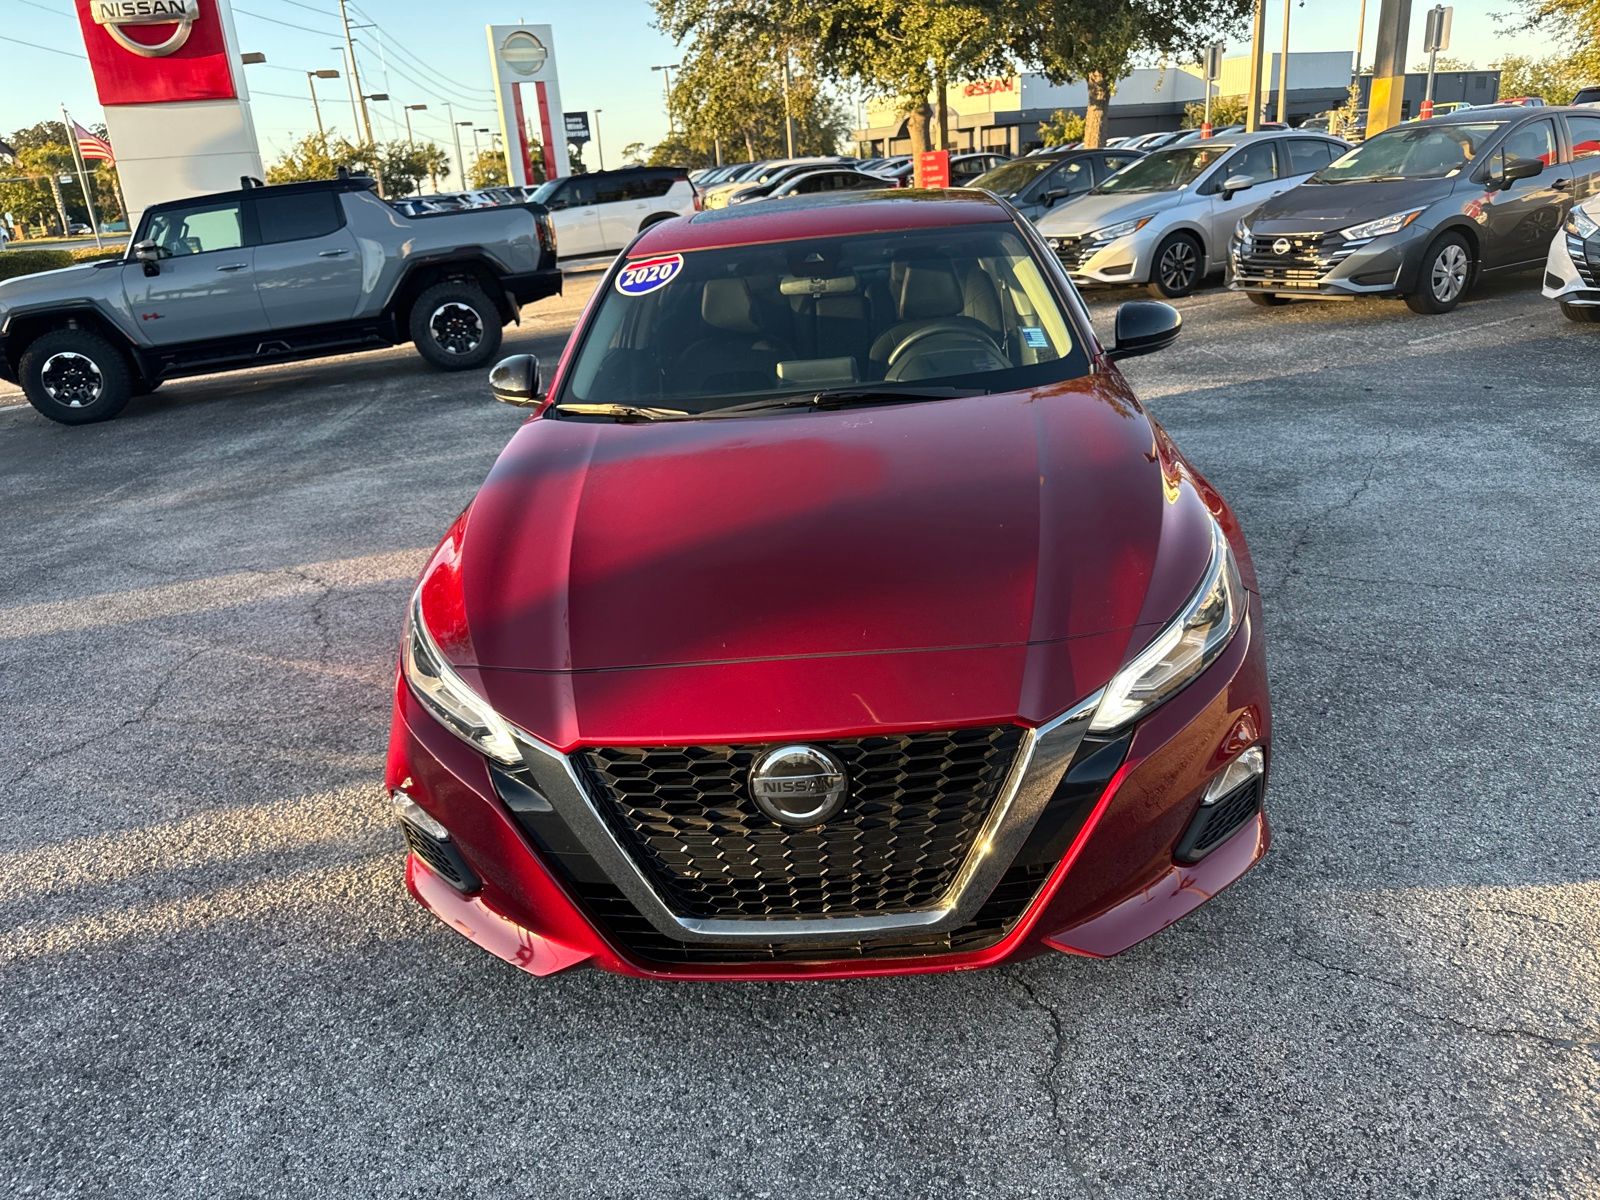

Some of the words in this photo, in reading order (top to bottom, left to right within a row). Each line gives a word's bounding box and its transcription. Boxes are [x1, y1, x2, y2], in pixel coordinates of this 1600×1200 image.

[100, 1, 187, 17] NISSAN
[622, 263, 673, 287] 2020
[763, 777, 834, 792] NISSAN
